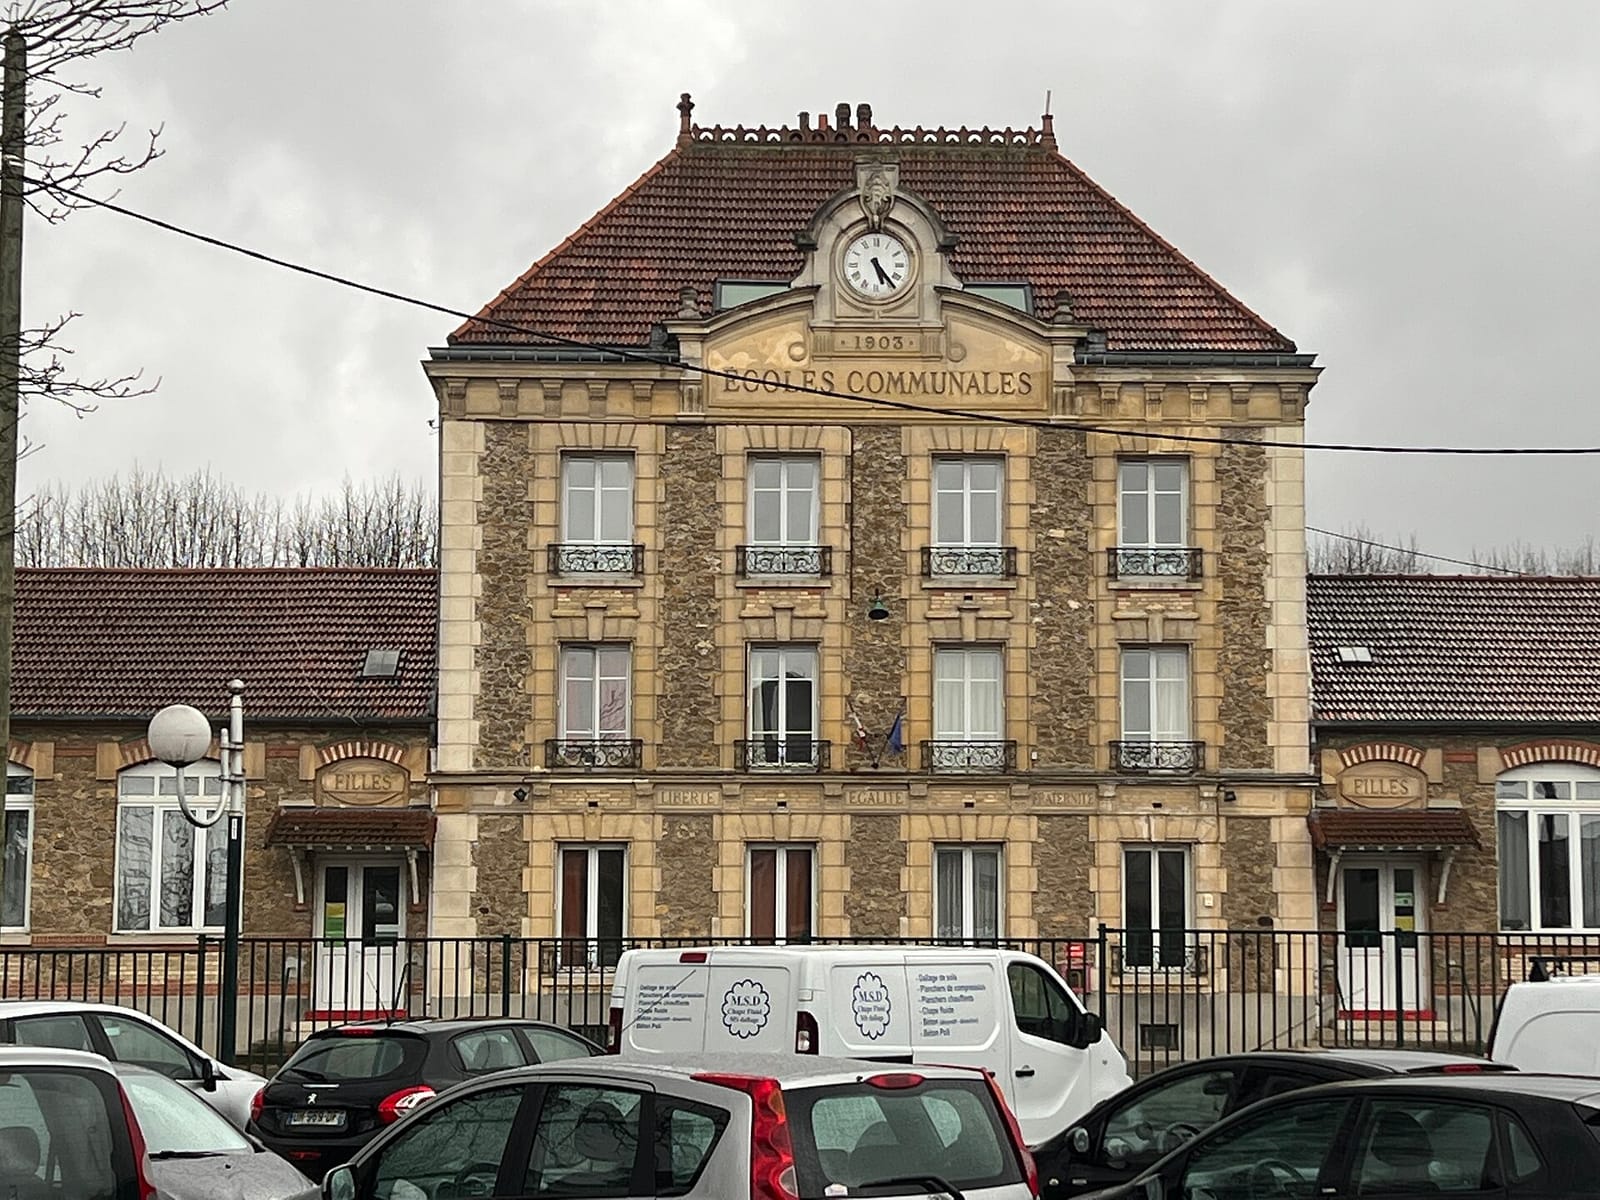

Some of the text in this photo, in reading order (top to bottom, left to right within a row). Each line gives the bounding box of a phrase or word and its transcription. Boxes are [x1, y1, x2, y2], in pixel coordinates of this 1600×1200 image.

[854, 335, 904, 350] 1903
[846, 370, 1033, 395] COMMUNALES
[335, 773, 392, 790] FILLES
[1354, 778, 1409, 795] FILLES
[730, 995, 761, 1006] M.S.D
